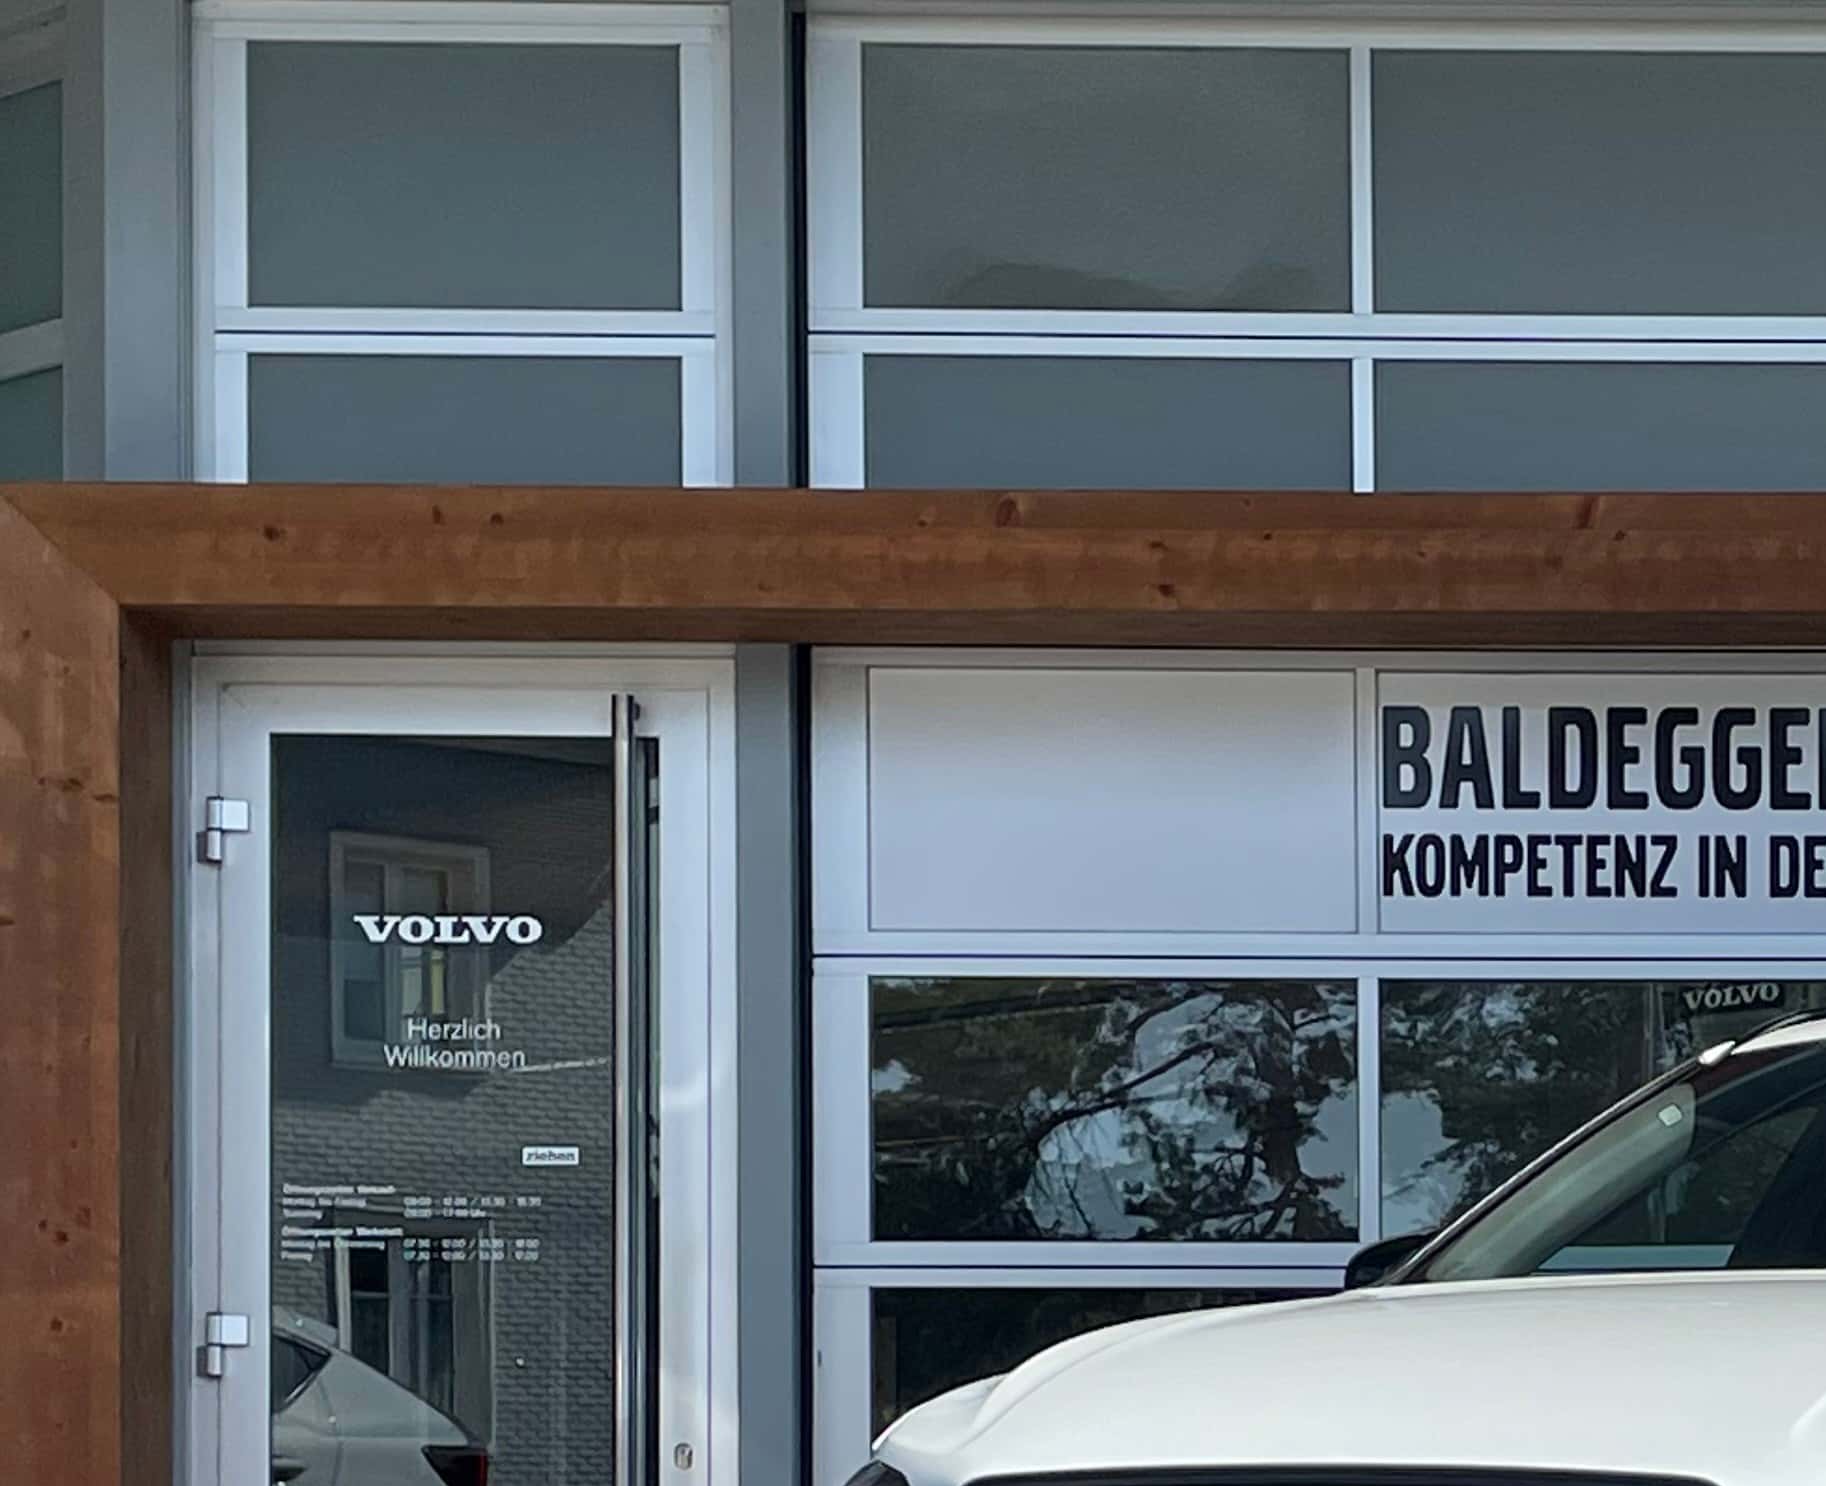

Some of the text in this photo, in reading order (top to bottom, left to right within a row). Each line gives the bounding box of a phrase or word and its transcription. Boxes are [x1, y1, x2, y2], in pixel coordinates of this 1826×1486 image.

[1382, 833, 1679, 899] KOMPETENZ
[1699, 834, 1748, 899] IN
[353, 915, 542, 943] VOLVO
[1683, 982, 1780, 1010] VOLVO
[407, 1018, 501, 1040] Herzlich
[384, 1045, 526, 1068] Willkommen
